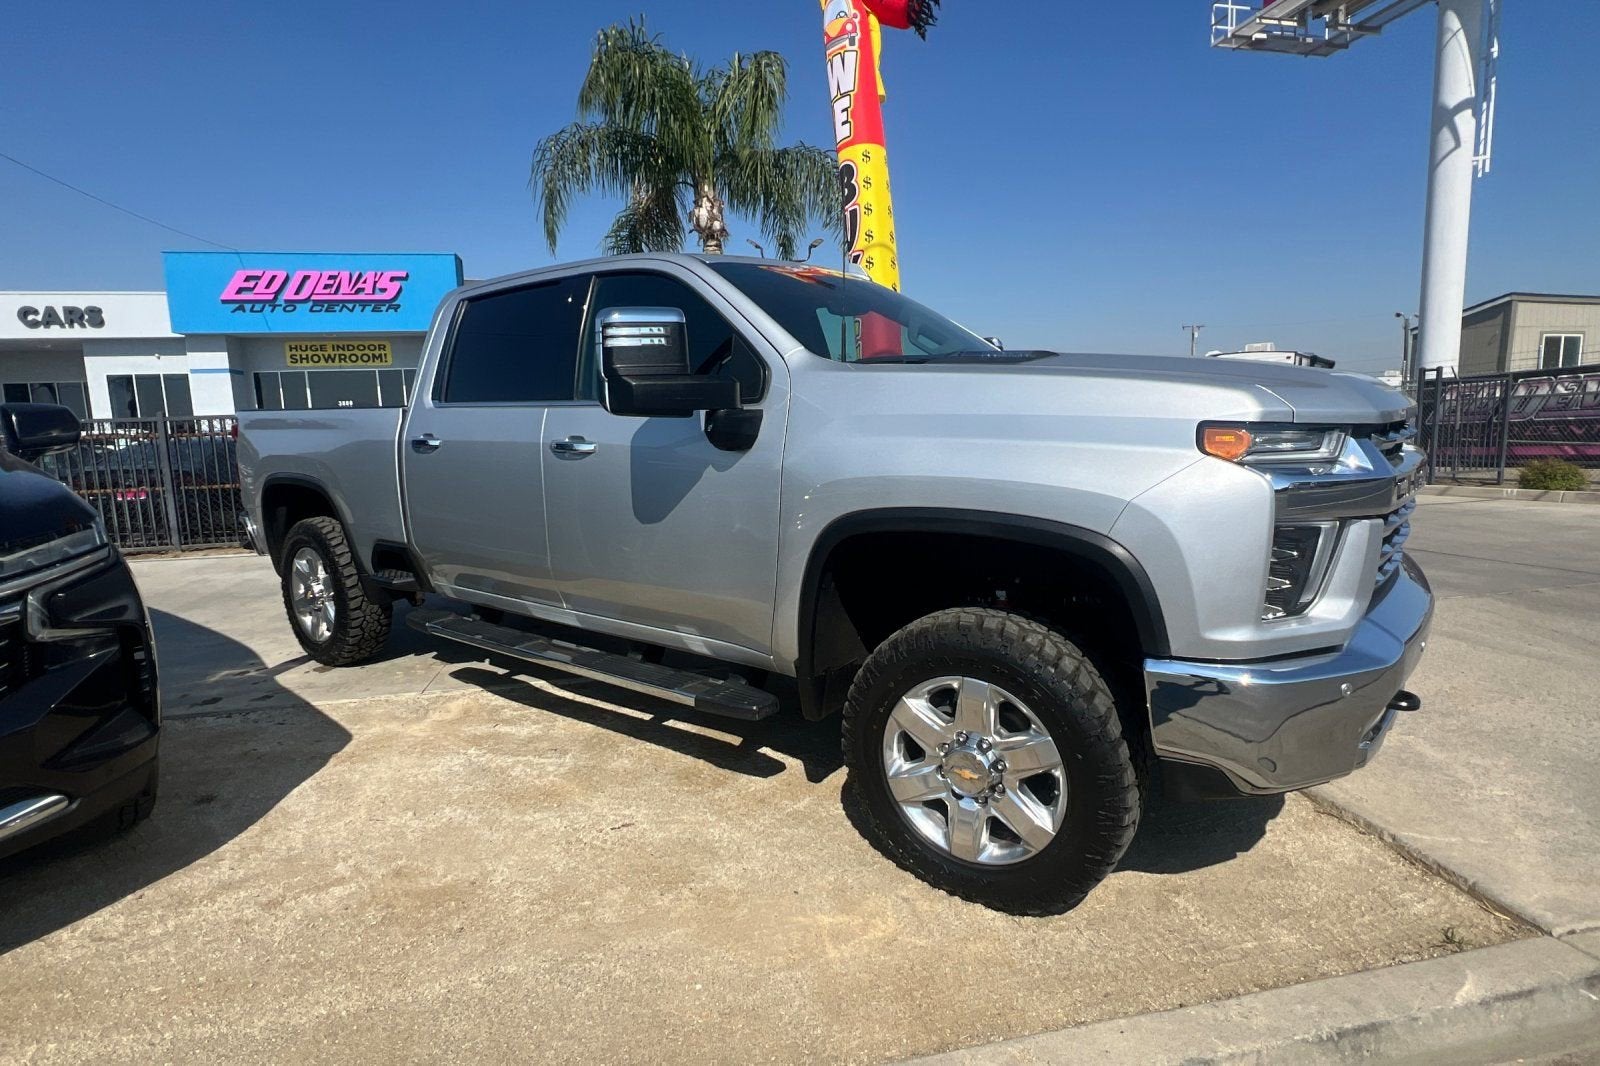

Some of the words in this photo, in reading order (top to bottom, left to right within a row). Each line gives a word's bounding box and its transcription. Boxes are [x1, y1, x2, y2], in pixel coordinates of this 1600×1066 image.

[826, 50, 858, 145] WE
[839, 161, 862, 264] BU
[219, 269, 290, 304] ED
[283, 271, 409, 304] DENA'S
[16, 305, 106, 330] CARS
[231, 303, 297, 313] AUTO
[309, 303, 402, 313] CENTER
[288, 344, 329, 353] HUGE
[331, 343, 387, 352] INDOOR
[289, 353, 389, 364] SHOWROOM!
